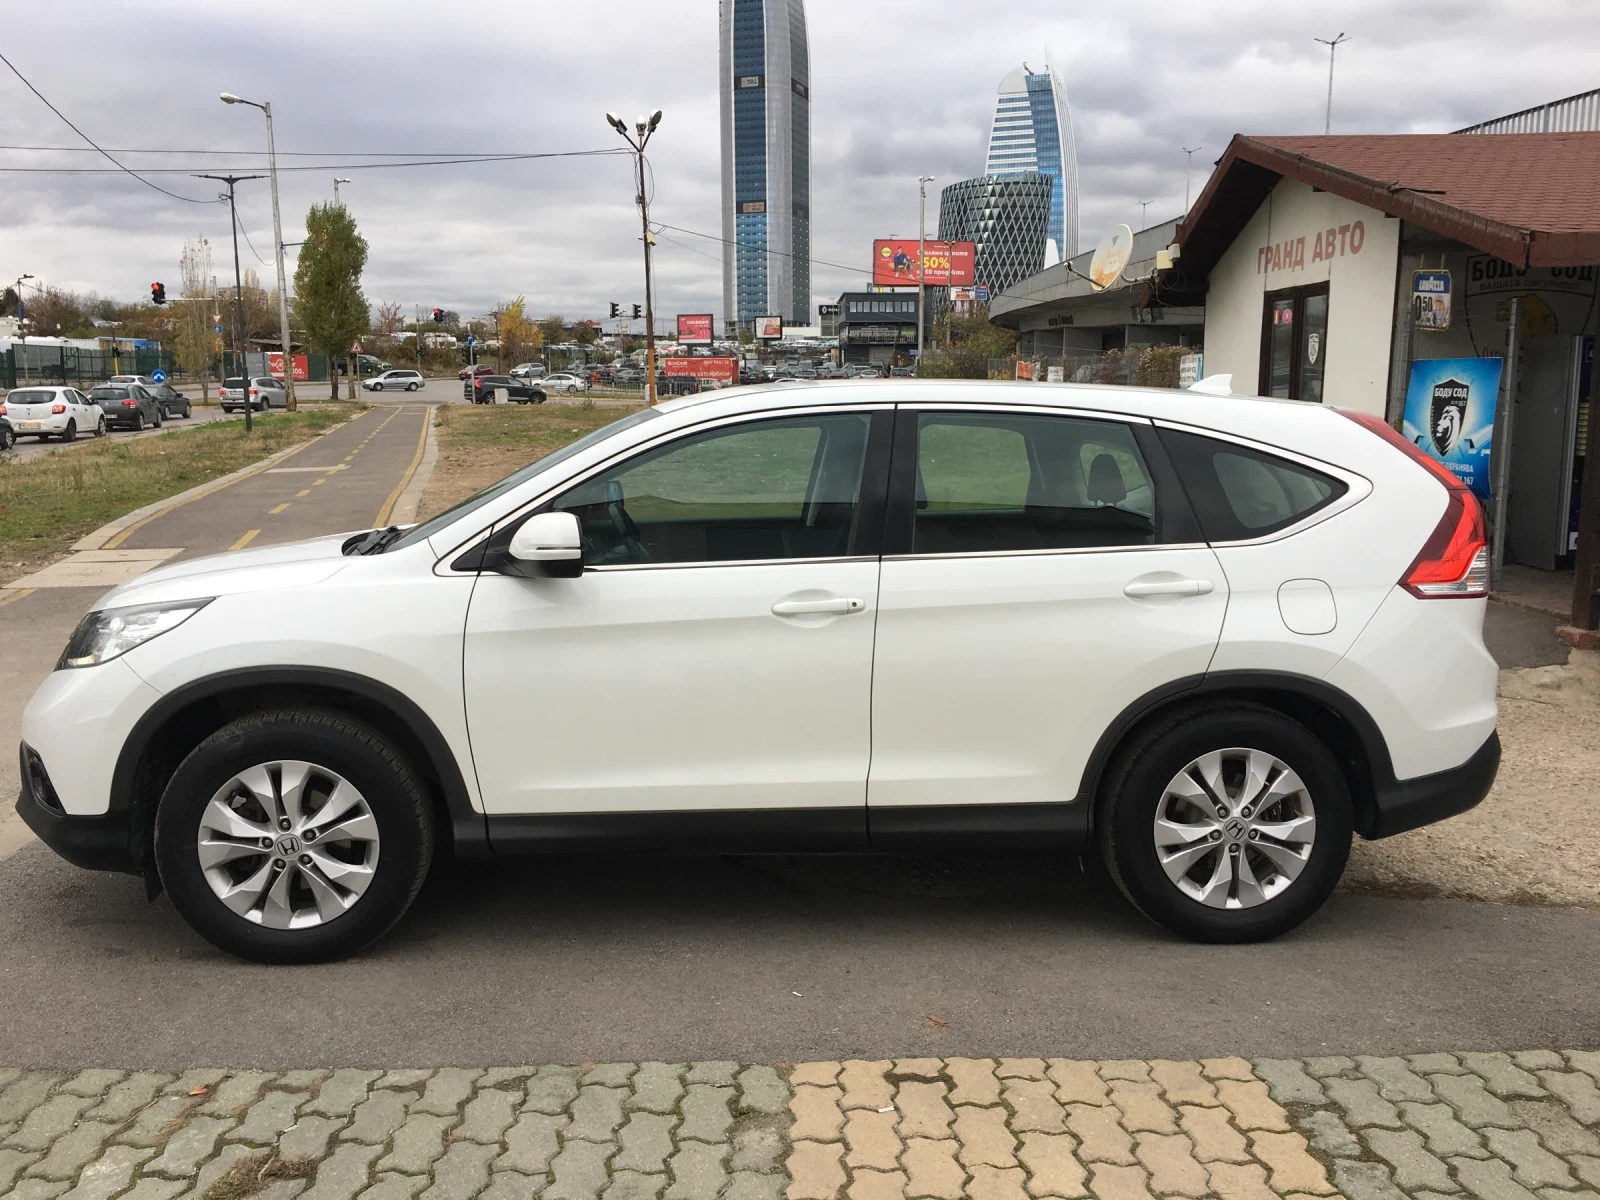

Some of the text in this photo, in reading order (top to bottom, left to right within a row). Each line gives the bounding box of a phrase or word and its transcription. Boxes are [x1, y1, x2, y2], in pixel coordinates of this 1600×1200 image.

[1258, 220, 1365, 275] ГРАНД АВТО
[1418, 276, 1445, 292] LAVAZZA
[1480, 280, 1583, 291] ВАШАТА СИГУРНОСТ
[1434, 387, 1468, 400] БОДУ СОД
[1464, 476, 1474, 486] 167
